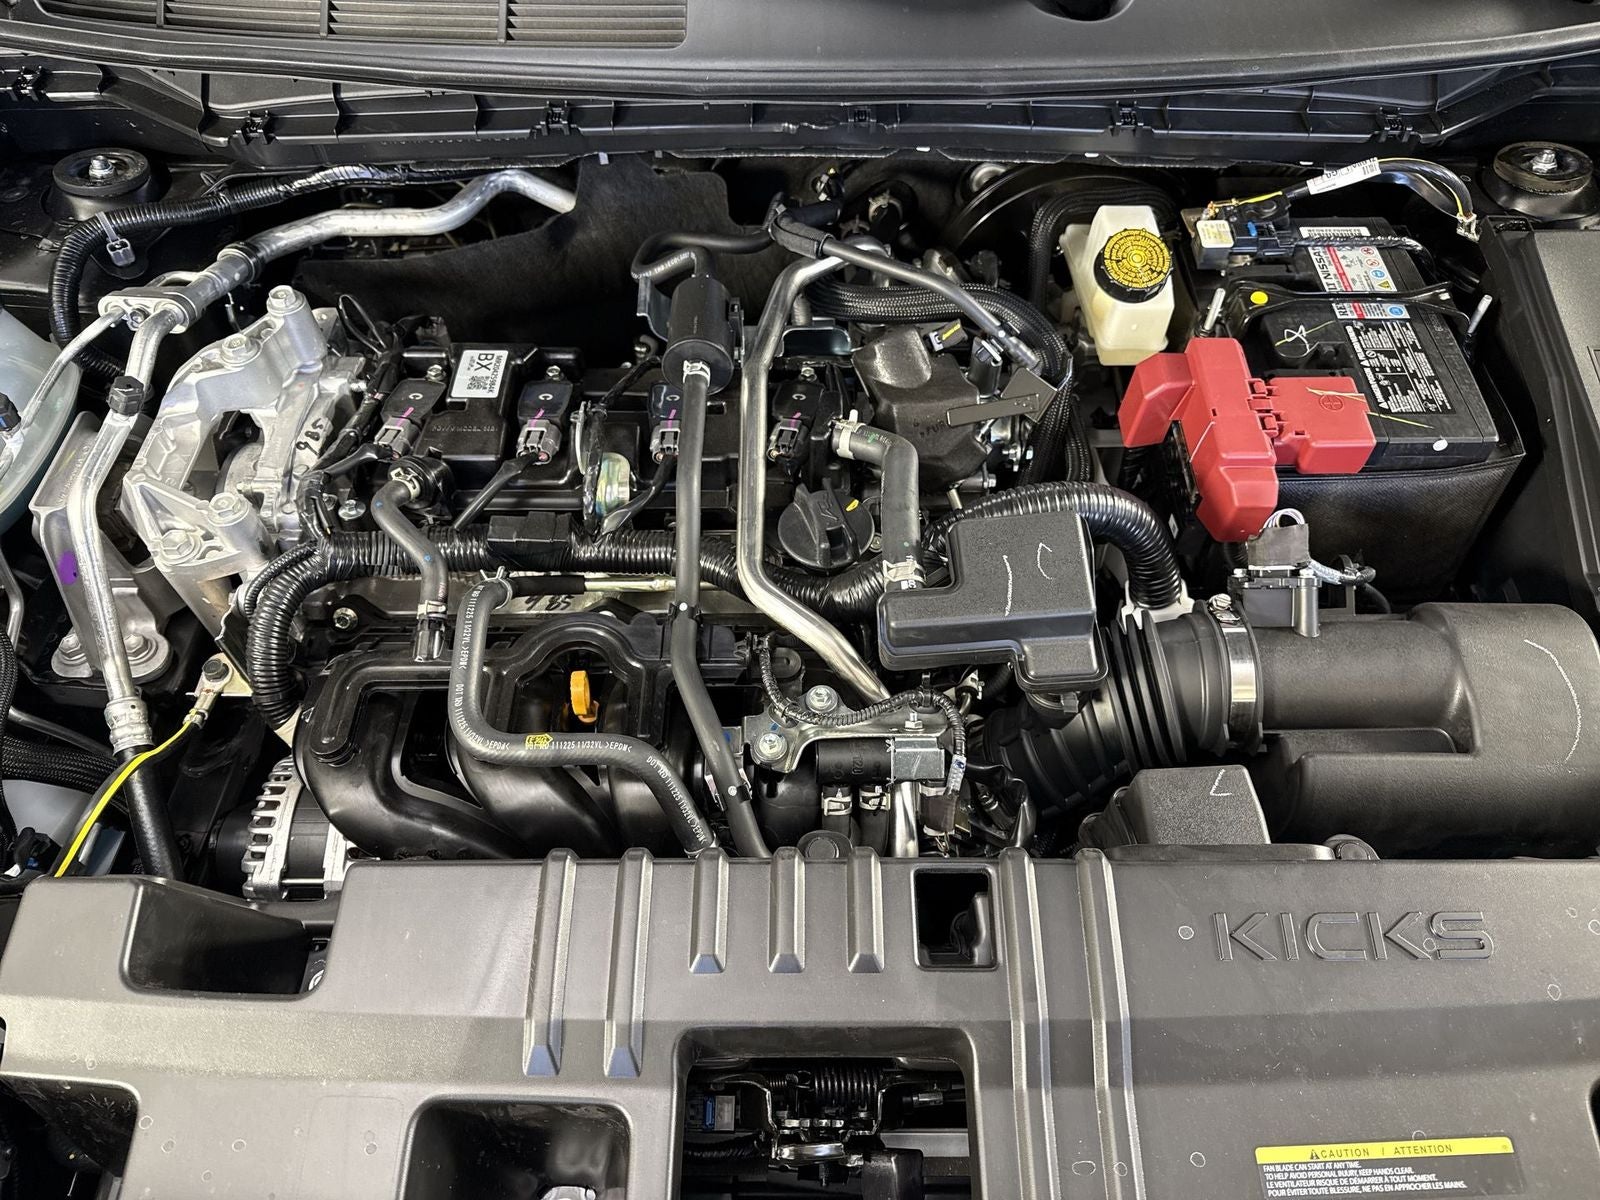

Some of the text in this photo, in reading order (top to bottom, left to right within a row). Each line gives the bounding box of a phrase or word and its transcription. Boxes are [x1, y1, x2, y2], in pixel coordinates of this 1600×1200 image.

[476, 353, 494, 371] BX
[465, 598, 477, 618] 111225
[552, 741, 575, 750] 111225
[665, 776, 683, 801] 111225
[1213, 912, 1494, 960] KICKS
[1320, 1148, 1370, 1158] CAUTION
[1394, 1144, 1453, 1155] ATTENTION
[1274, 1172, 1288, 1180] HELP
[1289, 1171, 1307, 1179] AVOID
[1307, 1170, 1337, 1178] PERSONAL
[1358, 1168, 1372, 1176] KEEP
[1372, 1167, 1394, 1175] HANDS
[1393, 1166, 1414, 1174] CLEAR.
[1307, 1162, 1324, 1170] START
[1267, 1188, 1286, 1197] POUR
[1286, 1187, 1308, 1196] ÉVITER
[1307, 1186, 1328, 1195] TOUTE
[1361, 1184, 1371, 1192] NE
[1371, 1184, 1384, 1192] PAS
[1394, 1182, 1431, 1191] APPROCHER
[1432, 1181, 1443, 1189] LES
[1443, 1180, 1467, 1188] MAINS.
[1274, 1179, 1315, 1188] VENTILATEUR
[1315, 1177, 1338, 1186] RISQUE
[1339, 1177, 1349, 1185] DE
[1389, 1174, 1406, 1183] TOUT
[1407, 1173, 1438, 1182] MOMENT.
